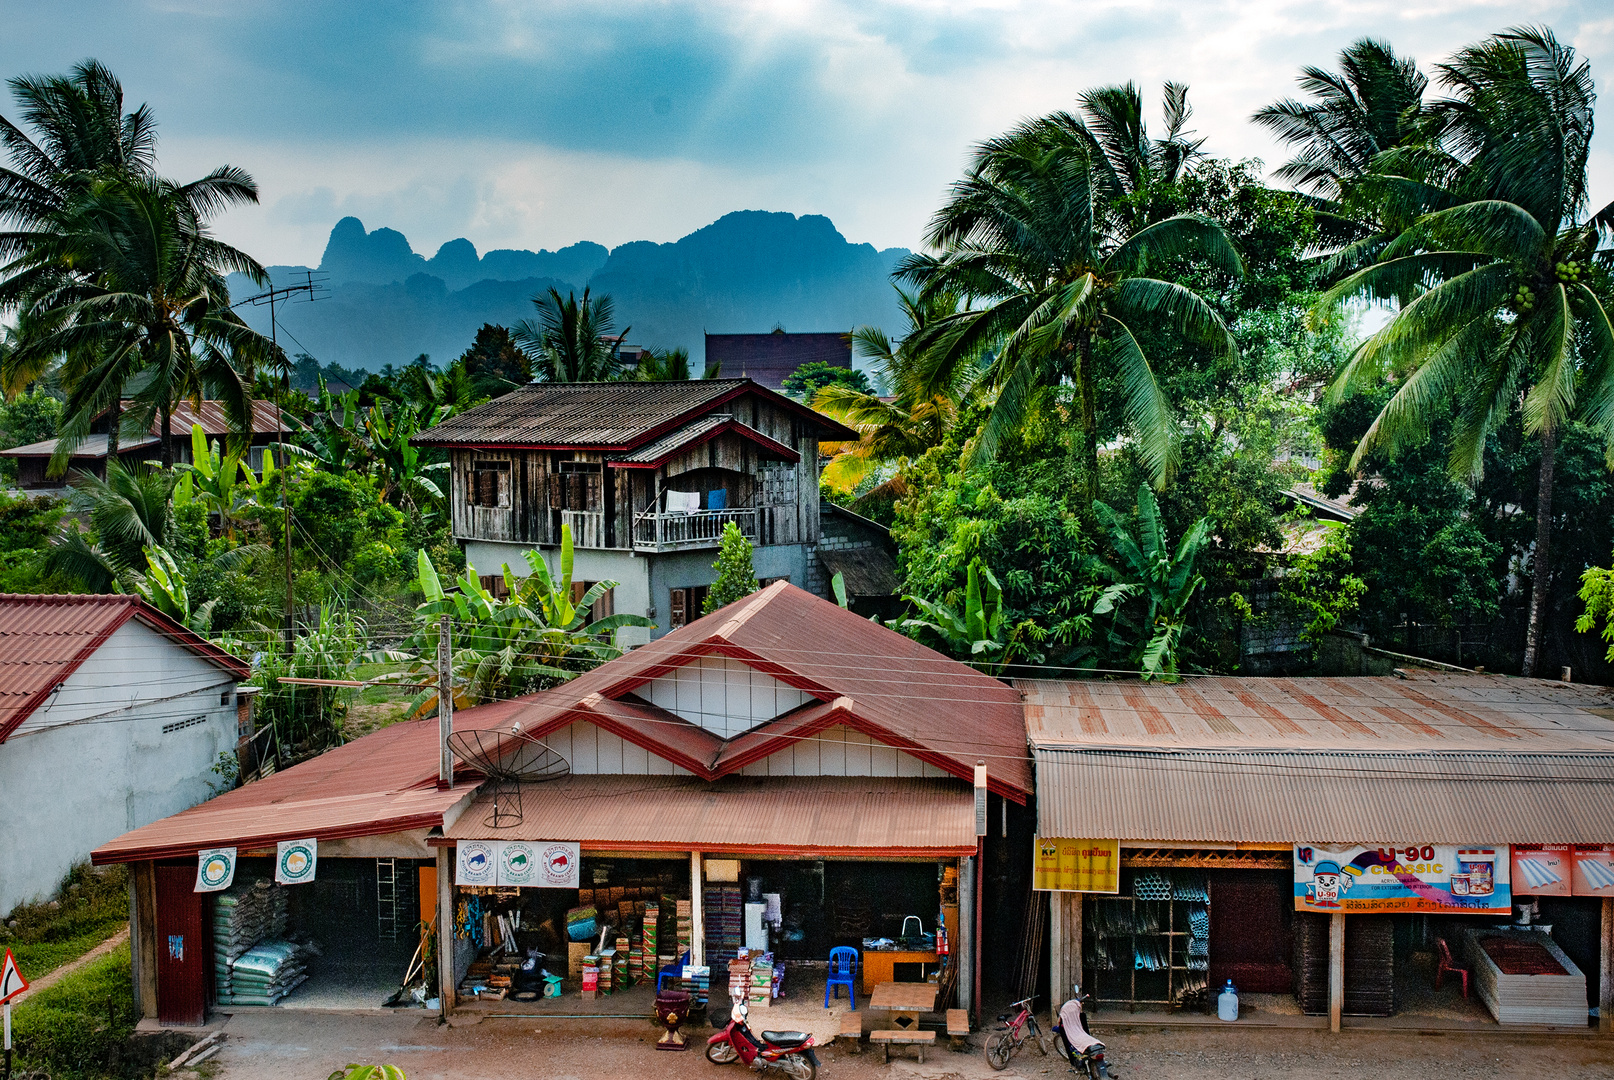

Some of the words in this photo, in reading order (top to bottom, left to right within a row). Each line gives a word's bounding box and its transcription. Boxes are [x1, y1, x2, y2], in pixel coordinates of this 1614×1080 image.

[1042, 848, 1056, 856] KP
[1378, 846, 1435, 862] U-90
[1371, 863, 1444, 875] CLASSIC
